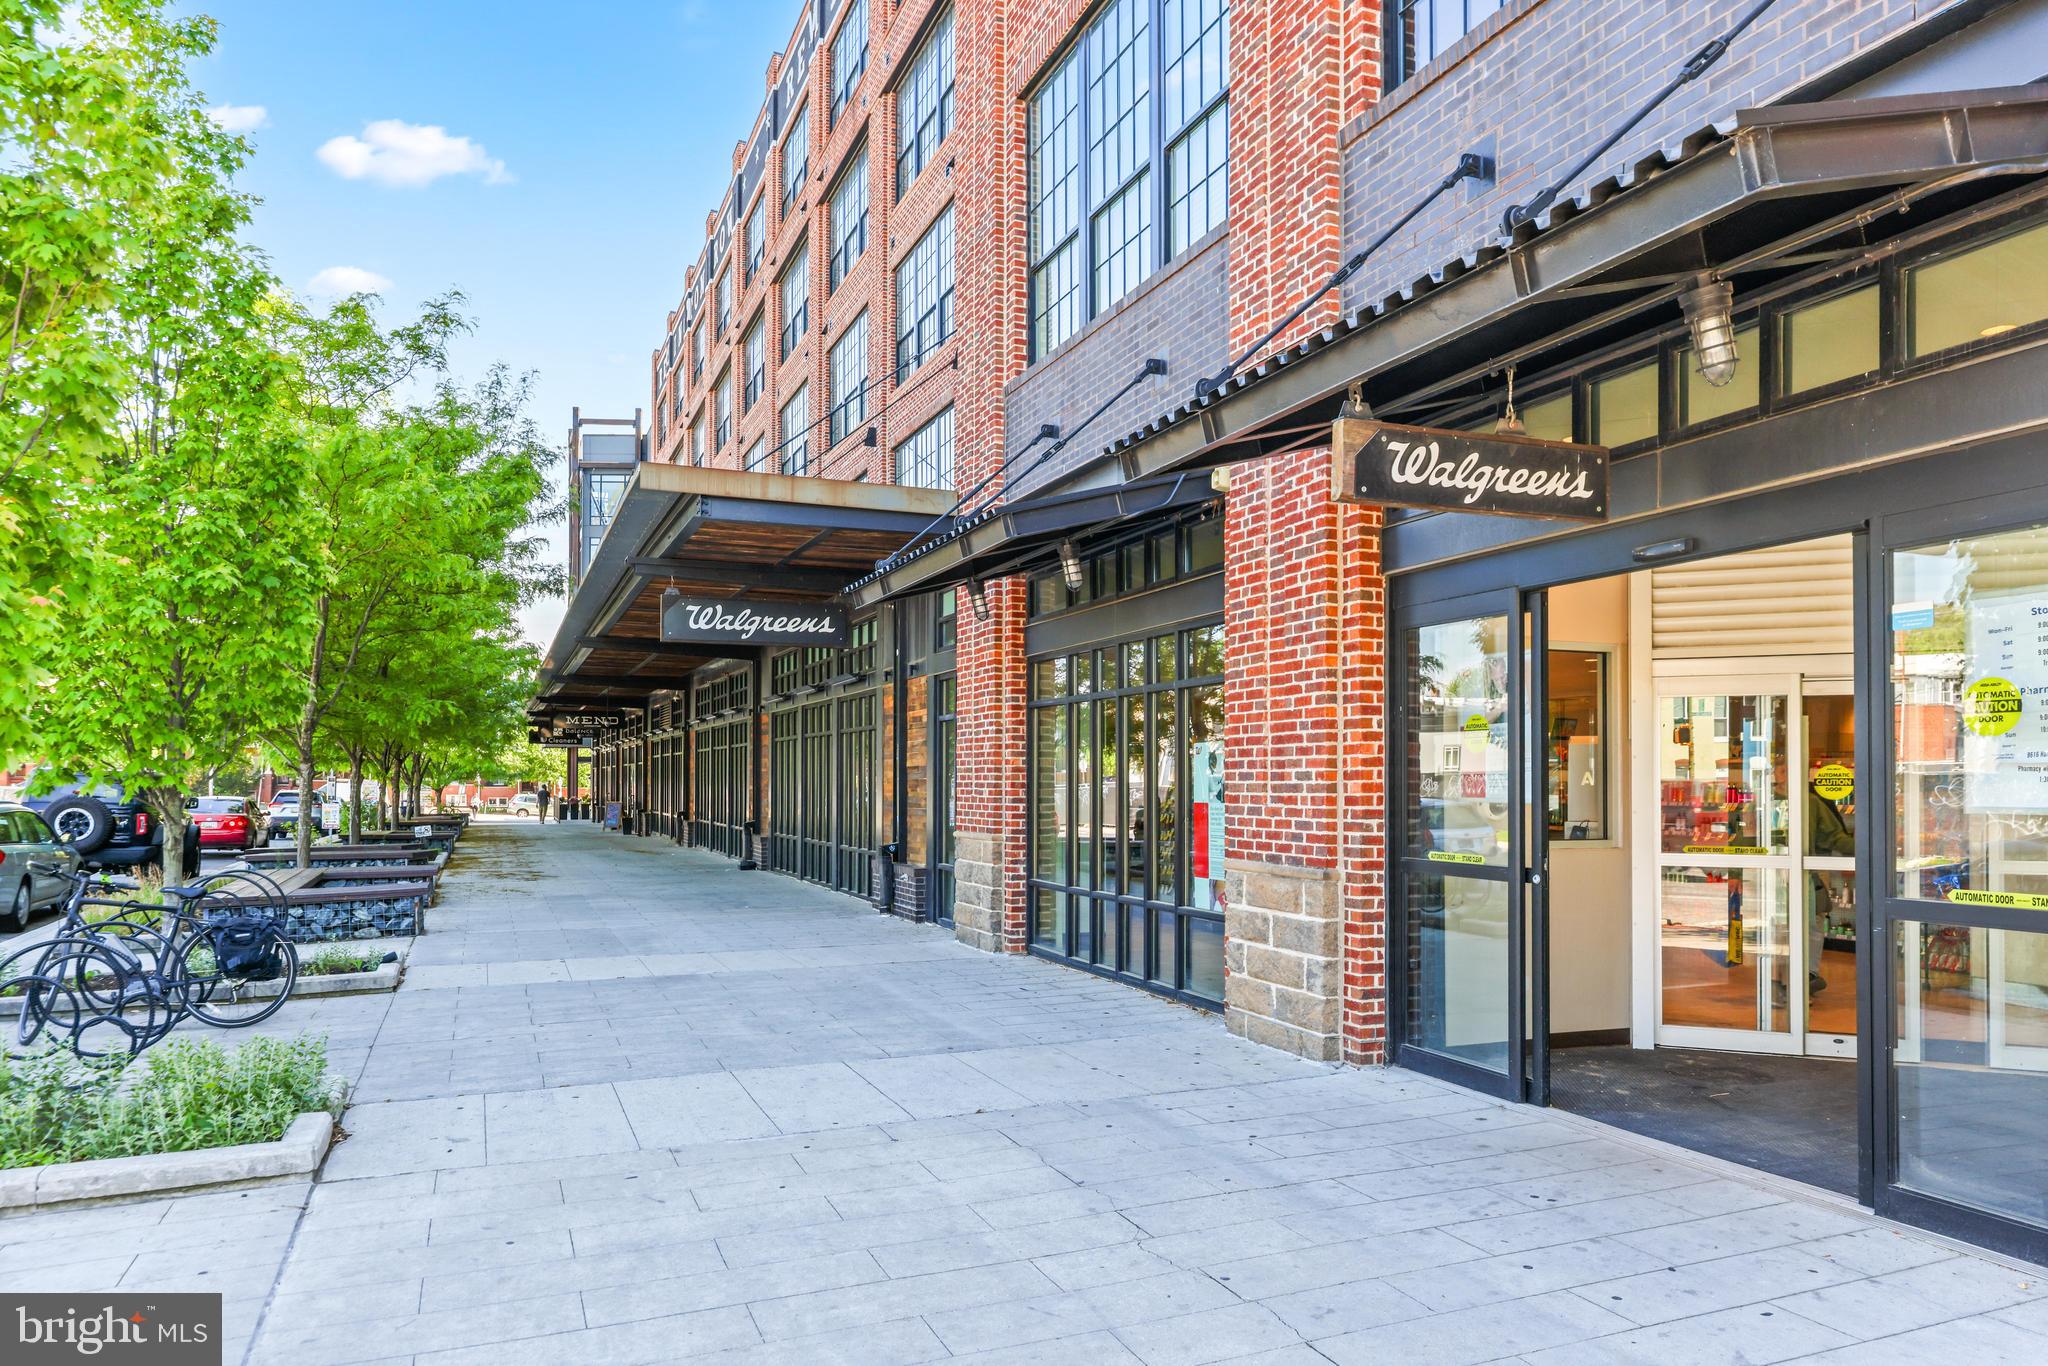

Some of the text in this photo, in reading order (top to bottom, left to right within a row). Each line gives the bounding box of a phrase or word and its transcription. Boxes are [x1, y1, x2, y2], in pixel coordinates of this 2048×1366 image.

[1386, 441, 1594, 504] Walgreens
[685, 604, 836, 639] Walgreens
[1971, 700, 2018, 713] AUTION
[565, 715, 619, 725] MEND
[1978, 714, 2004, 723] DOOR
[1815, 778, 1853, 787] CAUTION
[1955, 892, 1994, 903] AUTOMATIC
[1995, 894, 2015, 904] DOOR
